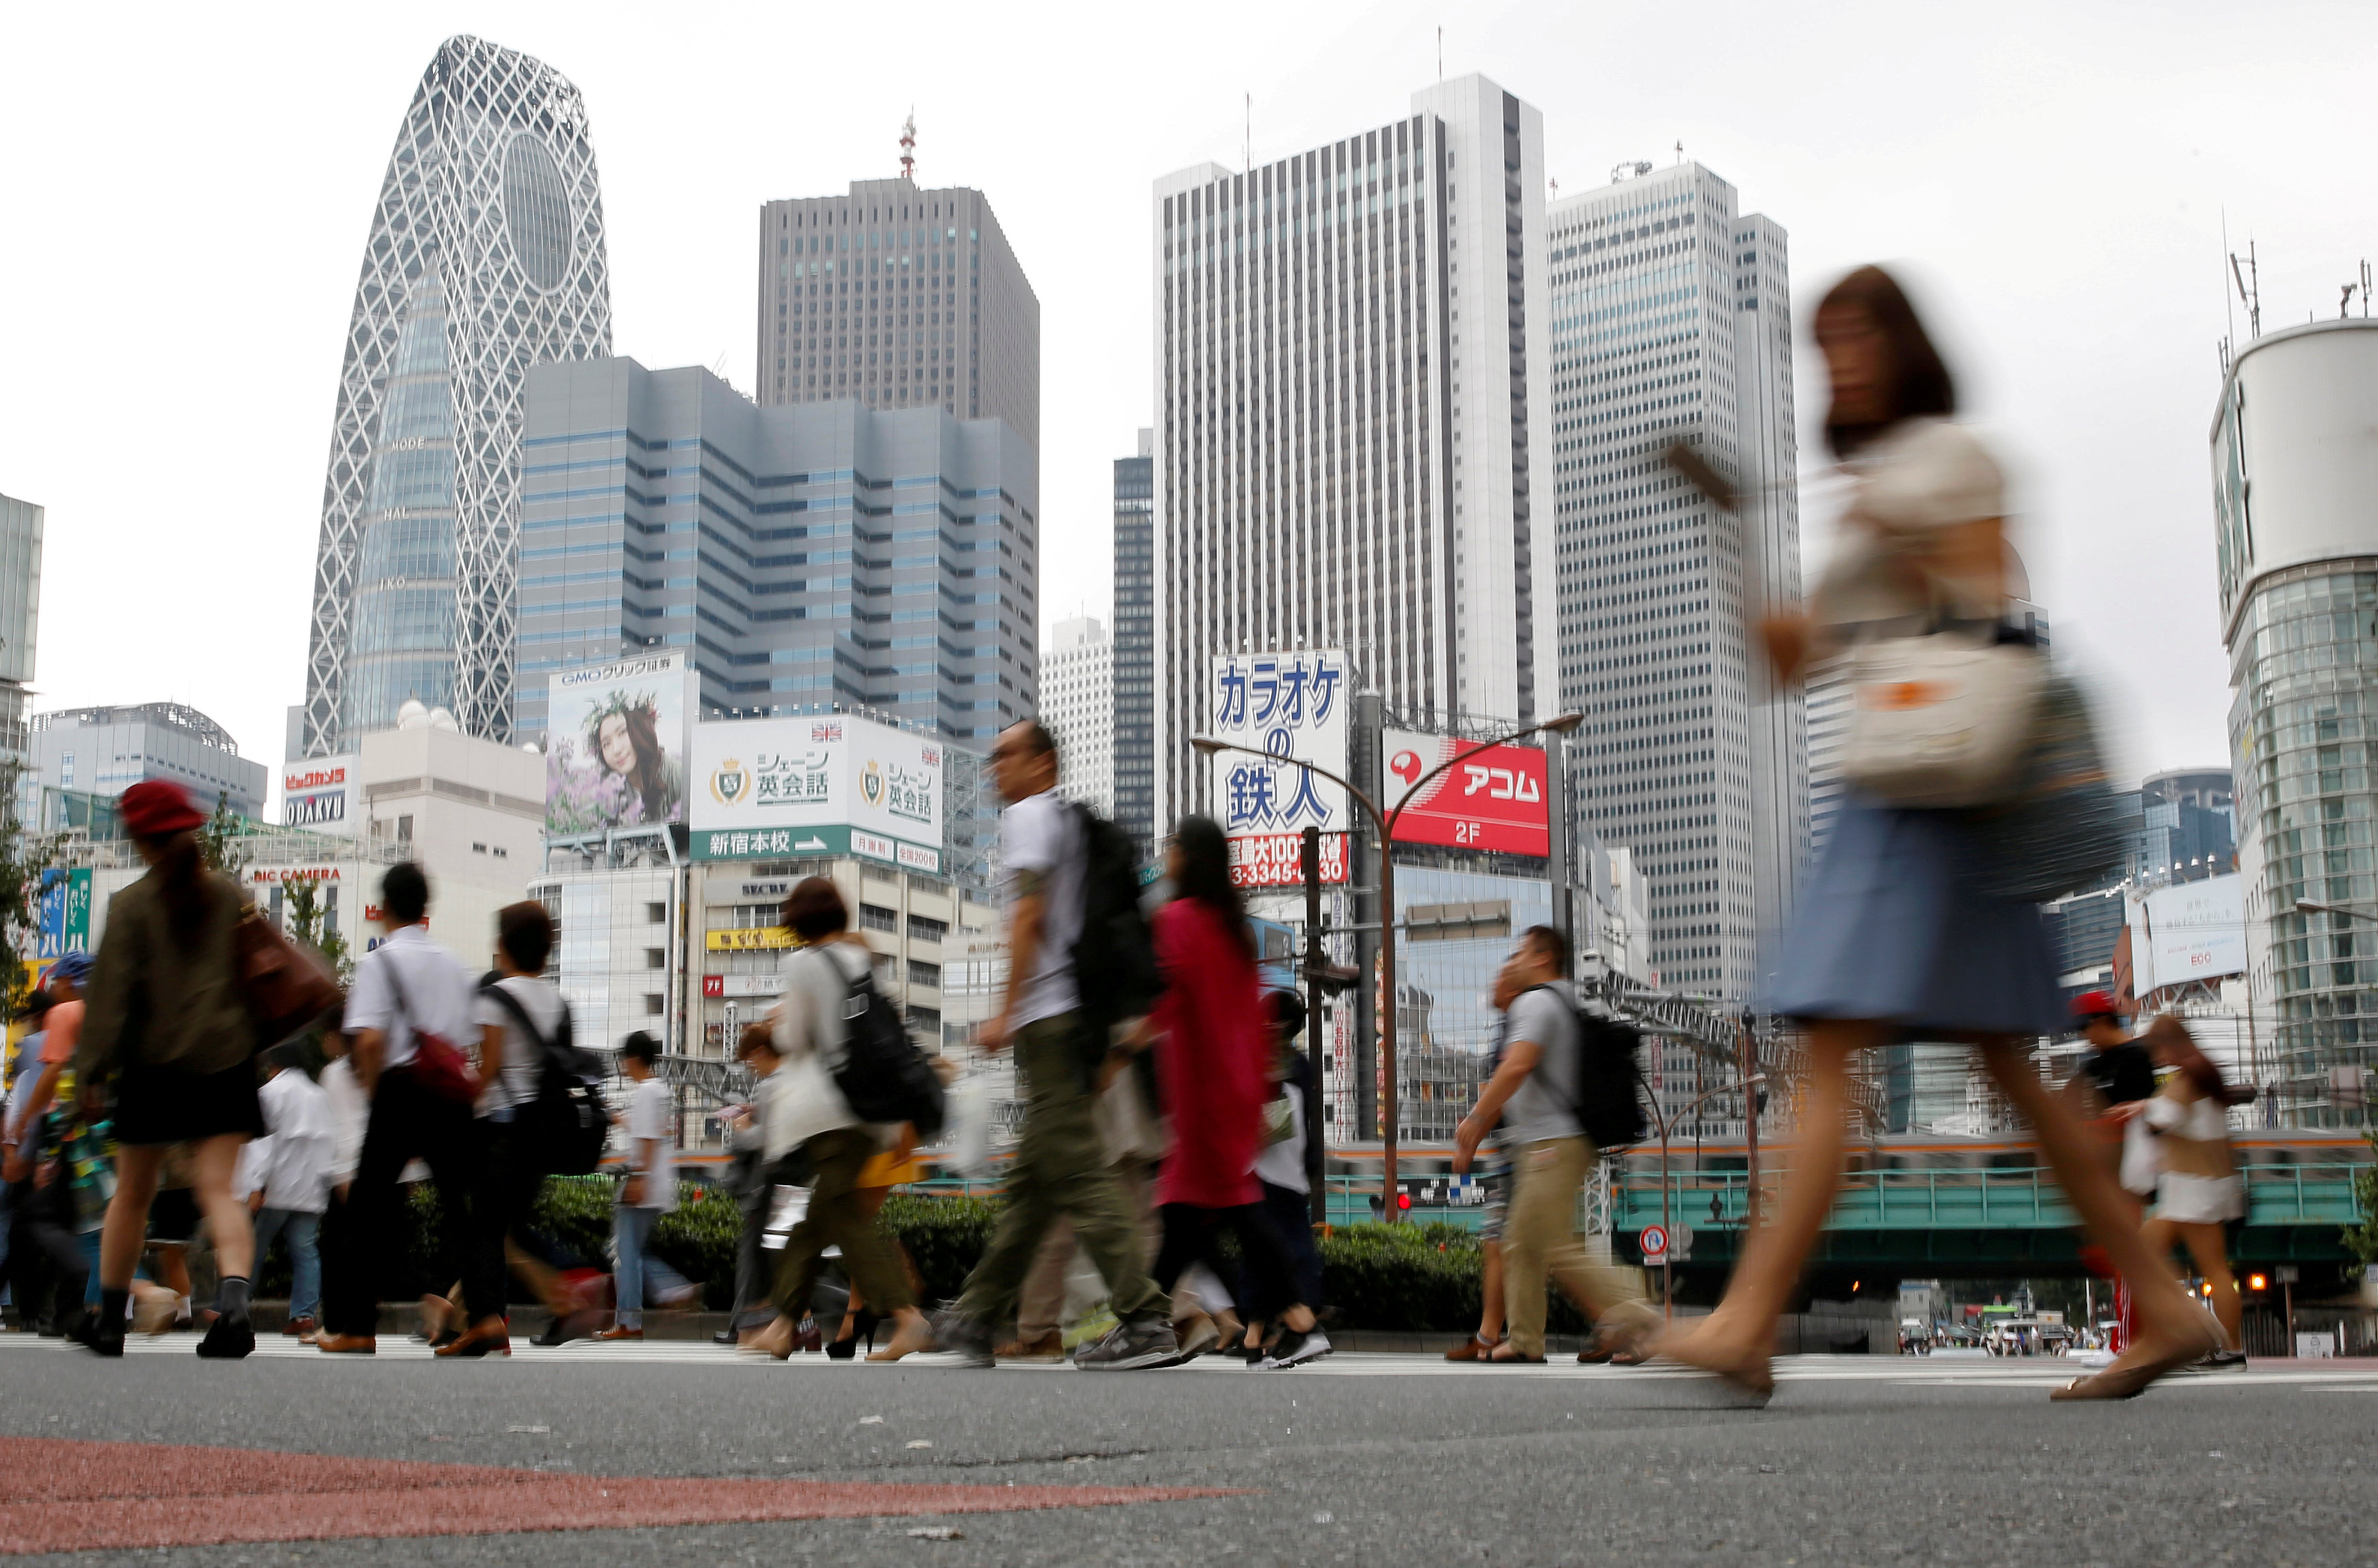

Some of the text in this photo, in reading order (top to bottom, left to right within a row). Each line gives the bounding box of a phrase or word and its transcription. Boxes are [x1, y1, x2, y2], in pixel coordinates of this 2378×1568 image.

[391, 436, 425, 452] MODE
[384, 505, 409, 521] HAL
[562, 657, 671, 686] GMOクリック証券
[1218, 656, 1342, 730] カラオケ
[1265, 726, 1293, 765] の
[758, 749, 829, 772] シェーン
[286, 768, 345, 790] ビックカメラ
[758, 772, 828, 798] 英会話
[889, 762, 931, 790] シェーン
[1464, 764, 1540, 802] アコム
[889, 783, 931, 817] 英会話
[1227, 762, 1332, 827] 鉄人
[286, 795, 342, 827] ODAKYU
[710, 830, 789, 856] 新宿本校
[1456, 821, 1480, 844] 2F
[900, 847, 936, 868] 全国200校
[253, 868, 340, 882] BIC CAMERA
